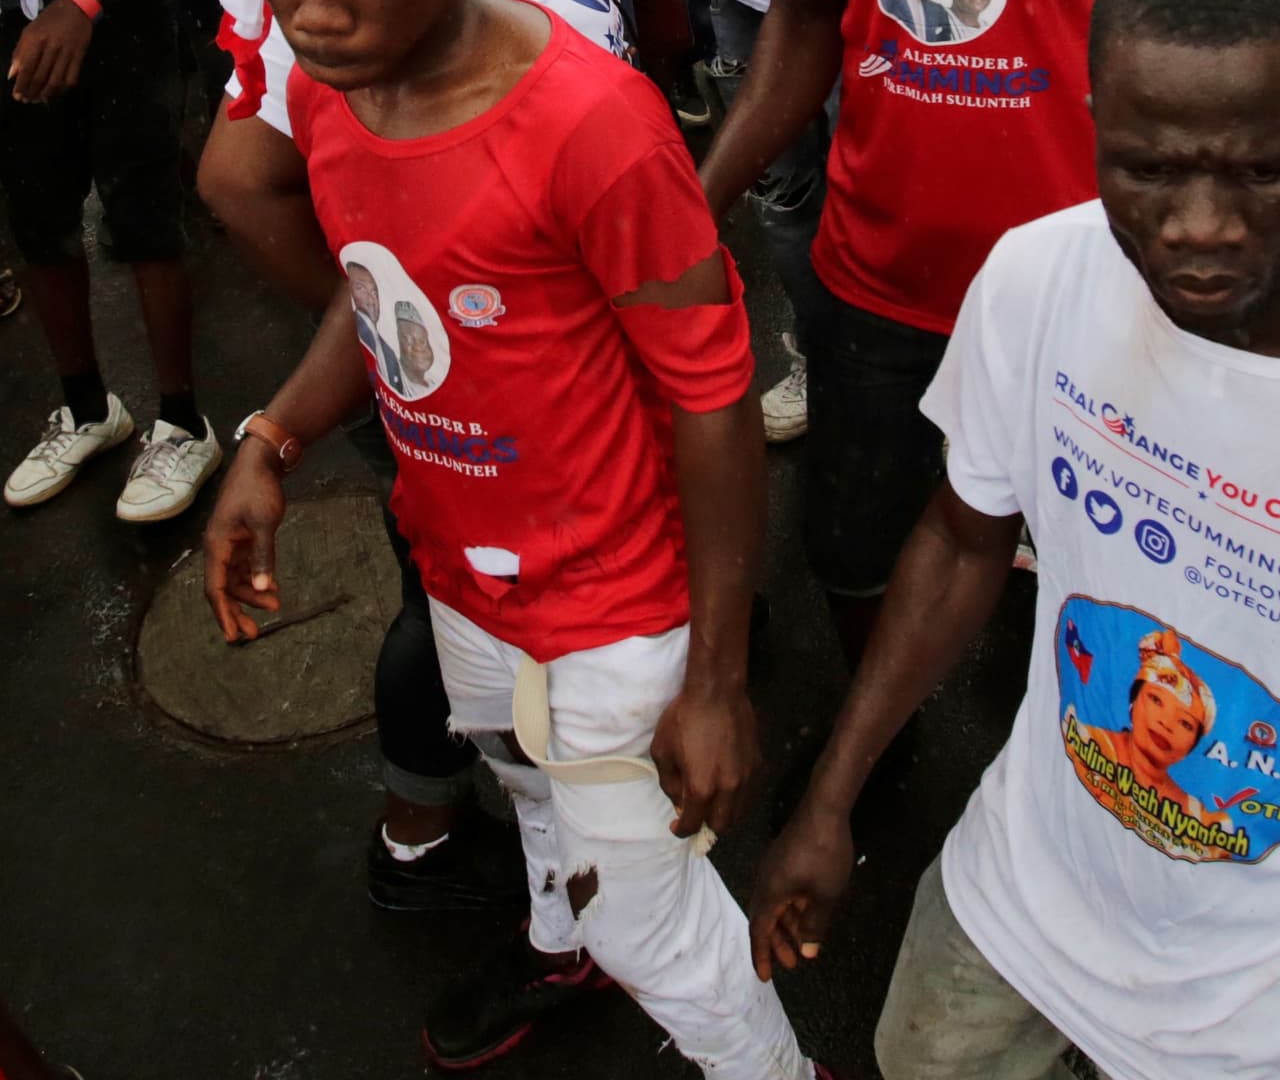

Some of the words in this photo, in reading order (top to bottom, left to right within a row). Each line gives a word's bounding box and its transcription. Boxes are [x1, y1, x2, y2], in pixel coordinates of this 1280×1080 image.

[904, 48, 1008, 70] ALEXANDER
[1013, 56, 1027, 70] B.
[946, 92, 1031, 109] SULUNTEH
[469, 423, 489, 436] B.
[1055, 372, 1097, 417] REAL
[1101, 403, 1200, 481] CHANGE
[1206, 468, 1259, 508] YOU
[413, 448, 498, 477] SULUNTEH
[1206, 741, 1238, 768] A.
[1066, 714, 1116, 781] Pauline
[1116, 765, 1160, 815] Weah
[1160, 797, 1251, 858] Nyanforh
